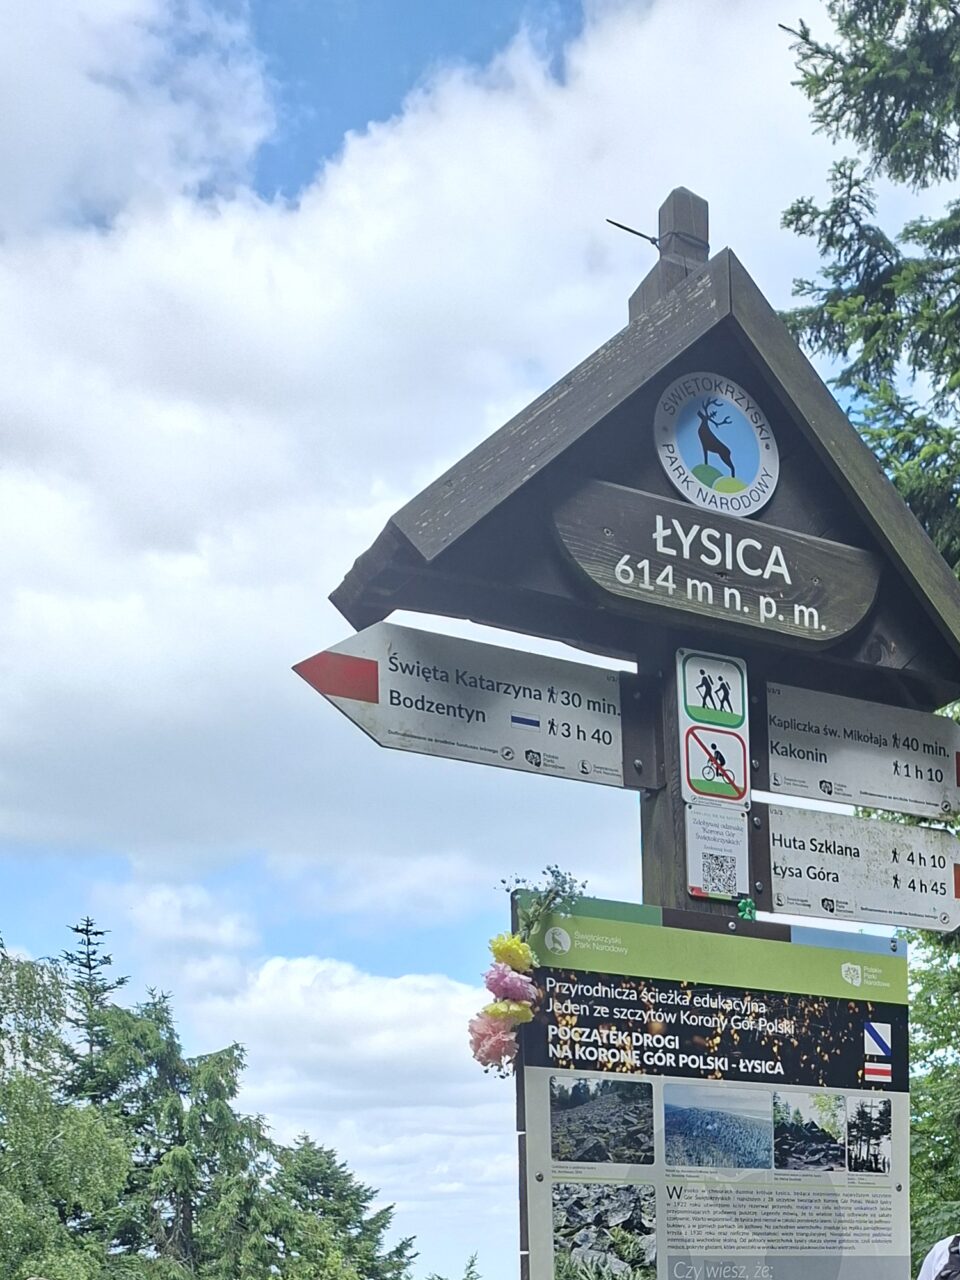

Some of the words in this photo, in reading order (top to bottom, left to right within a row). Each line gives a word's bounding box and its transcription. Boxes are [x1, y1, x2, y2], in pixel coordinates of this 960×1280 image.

[664, 377, 767, 441] ŚWIĘTOKRZYSKI
[662, 442, 694, 491] PARK
[696, 466, 774, 511] NARODOWY
[653, 515, 791, 584] ŁYSICA
[615, 555, 676, 595] 614
[687, 578, 713, 604] m
[724, 587, 750, 613] n.
[760, 594, 784, 623] p.
[794, 603, 827, 631] m.
[388, 652, 449, 684] Święta
[455, 669, 543, 702] Katarzyna
[561, 690, 582, 709] 30
[587, 697, 621, 717] min.
[389, 690, 486, 723] Bodzentyn
[561, 722, 571, 739] 3
[576, 724, 587, 742] h
[591, 729, 613, 746] 40
[768, 714, 821, 736] Kapliczka
[823, 726, 841, 740] św.
[843, 728, 888, 748] Mikołaja
[902, 736, 920, 752] 40
[923, 741, 950, 758] min.
[770, 741, 828, 764] Kakonin
[903, 764, 911, 778] 1
[914, 766, 924, 781] h
[927, 768, 943, 782] 10
[771, 833, 806, 851] Huta
[809, 838, 860, 859] Szklana
[907, 853, 918, 868] 4
[918, 853, 928, 868] h
[930, 855, 946, 869] 10
[772, 861, 802, 882] Łysa
[806, 864, 840, 884] Góra
[908, 878, 918, 893] 4
[919, 879, 928, 894] h
[930, 881, 947, 896] 45
[574, 940, 592, 950] Park
[592, 942, 629, 955] Narodowy
[546, 977, 638, 1000] Przyrodnicza
[641, 987, 690, 1006] ścieżka
[693, 993, 766, 1014] edukacyjna
[546, 998, 590, 1016] Jeden
[593, 1005, 610, 1017] ze
[613, 1008, 677, 1024] szczytów
[680, 1010, 728, 1030] Korony
[731, 1013, 756, 1031] Gór
[758, 1018, 795, 1034] Polski
[547, 1024, 629, 1046] POCZĄTEK
[631, 1032, 680, 1050] DROGI
[548, 1043, 573, 1060] NA
[574, 1045, 641, 1067] KORONĘ
[643, 1049, 677, 1067] GÓR
[679, 1054, 729, 1071] POLSKI
[738, 1059, 785, 1075] ŁYSICA
[673, 1261, 703, 1280] Czy
[705, 1261, 749, 1280] wiesz,
[754, 1261, 774, 1279] że:
